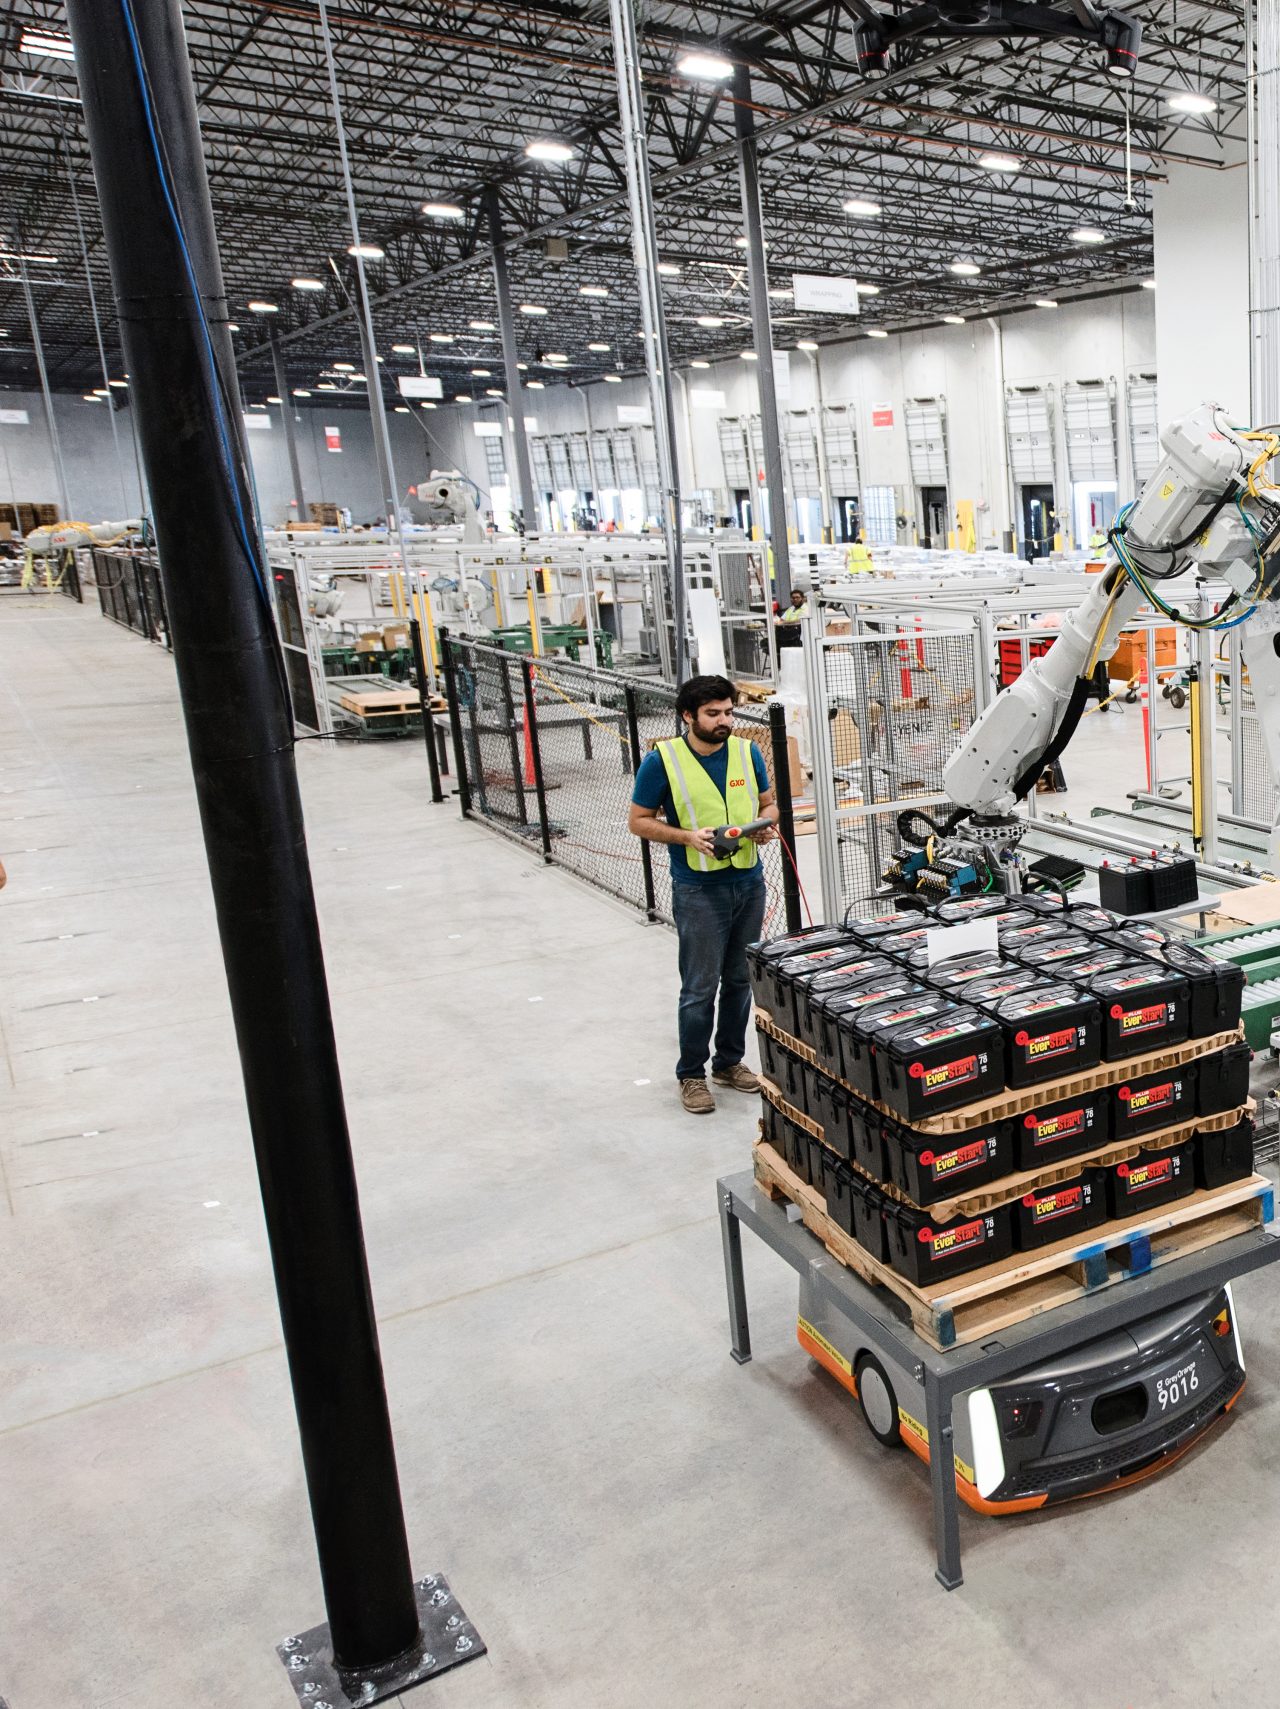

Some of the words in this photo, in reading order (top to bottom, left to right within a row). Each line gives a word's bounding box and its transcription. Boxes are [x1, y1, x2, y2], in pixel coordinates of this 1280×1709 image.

[730, 779, 744, 788] GXO
[1124, 1006, 1164, 1028] EverStart
[1168, 1004, 1176, 1013] 78
[1030, 1032, 1072, 1054] EverStart
[1078, 1028, 1086, 1037] 78
[978, 1055, 987, 1064] 78
[926, 1058, 974, 1086] EverStart
[1131, 1087, 1170, 1108] EverStart
[1175, 1083, 1182, 1091] 78
[1086, 1110, 1093, 1118] 78
[1038, 1114, 1080, 1136] EverStart
[988, 1139, 996, 1148] 78
[936, 1144, 983, 1172] EverStart
[1173, 1158, 1180, 1167] 78
[1130, 1163, 1168, 1184] EverStart
[1083, 1186, 1091, 1195] 78
[1037, 1191, 1079, 1215] EverStart
[985, 1219, 994, 1229] 78
[934, 1225, 980, 1250] EverStart
[1164, 1362, 1196, 1386] GreyOrange
[1158, 1370, 1199, 1410] 9016
[902, 1412, 908, 1422] No
[908, 1418, 922, 1436] Riding
